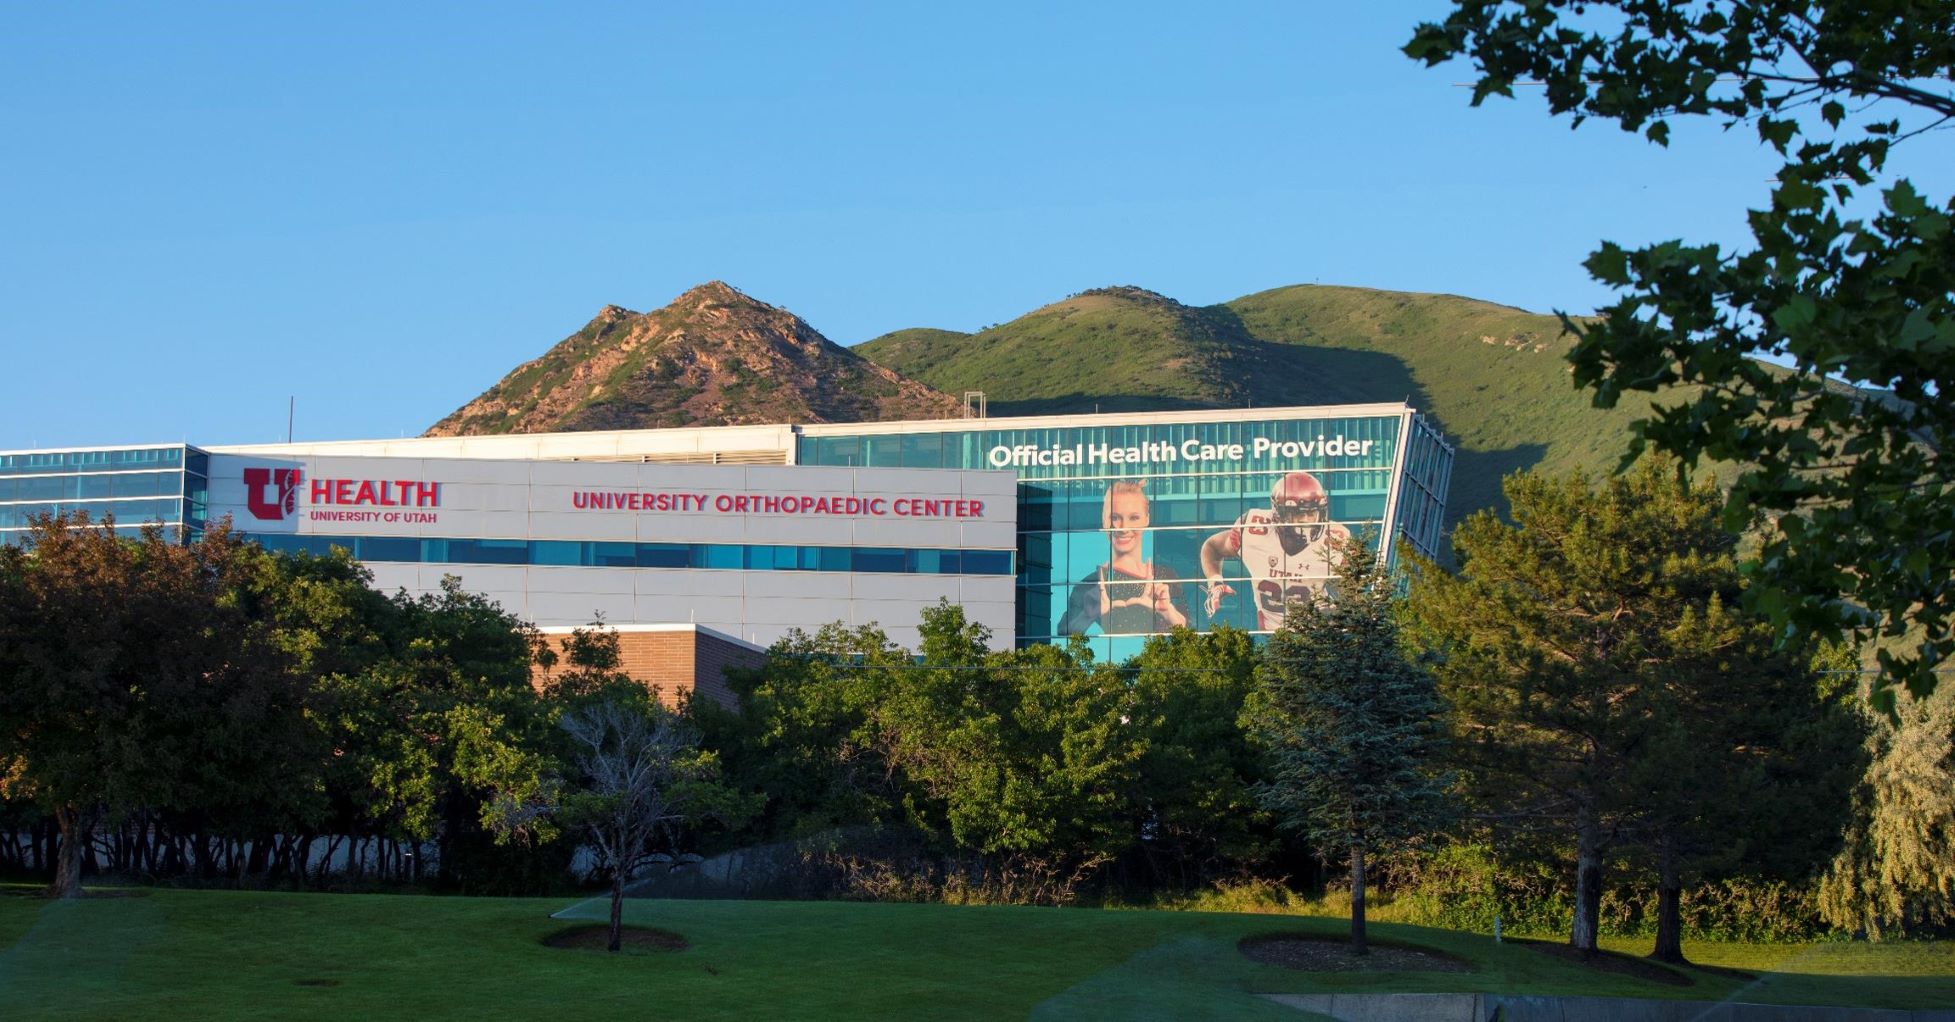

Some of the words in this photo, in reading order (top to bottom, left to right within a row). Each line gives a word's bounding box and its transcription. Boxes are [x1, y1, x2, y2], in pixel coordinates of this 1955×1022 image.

[989, 443, 1083, 467] Official
[1088, 440, 1177, 464] Health
[1180, 439, 1244, 461] Care
[1253, 435, 1374, 459] Provider
[244, 468, 301, 520] U
[310, 479, 437, 507] HEALTH
[572, 491, 707, 512] UNIVERSITY
[715, 494, 887, 516] ORTHOPAEDIC
[893, 498, 984, 518] CENTER
[310, 510, 381, 522] UNIVERSITY
[383, 512, 401, 522] OF
[403, 513, 437, 523] UTAH
